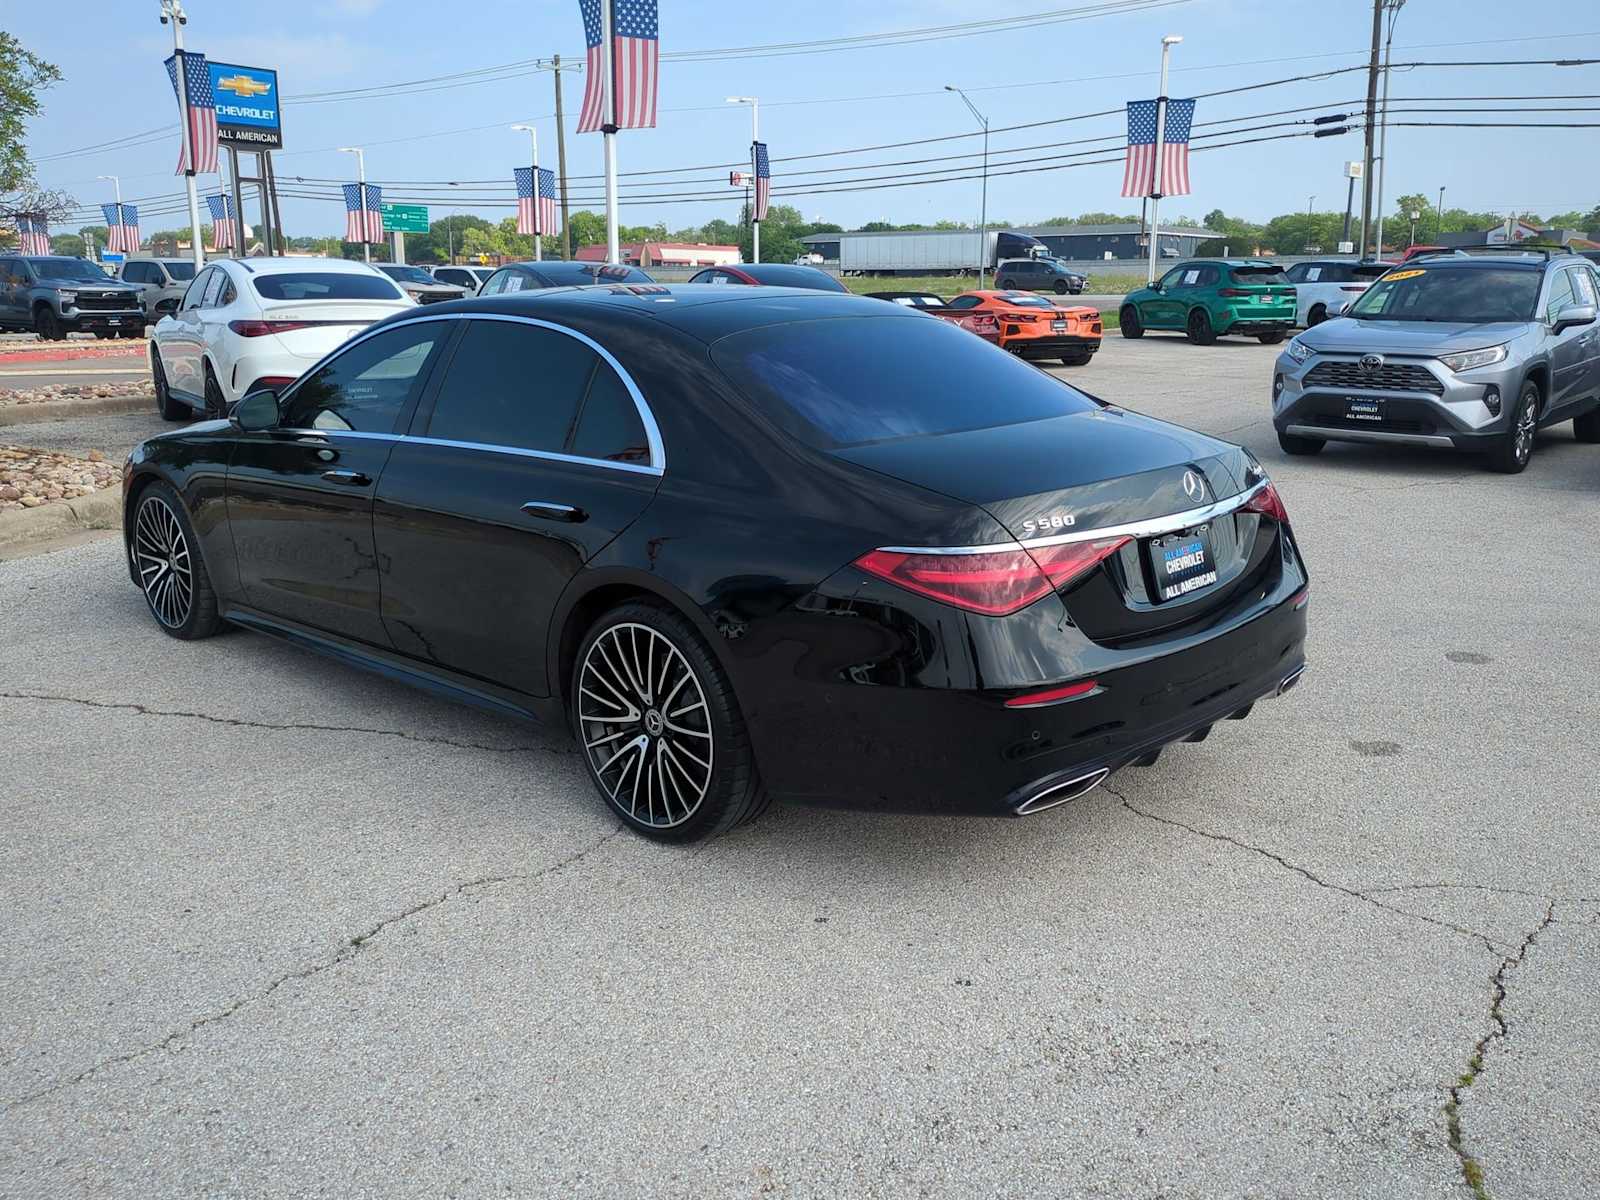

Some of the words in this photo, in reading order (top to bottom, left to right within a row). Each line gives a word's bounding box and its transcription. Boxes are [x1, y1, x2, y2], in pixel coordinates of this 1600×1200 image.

[215, 104, 275, 120] CHEVROLET
[218, 129, 234, 139] ALL
[235, 131, 278, 143] AMERICAN
[1351, 405, 1378, 413] CHEVROLET
[1022, 520, 1036, 532] S
[1037, 515, 1076, 529] 580
[1166, 550, 1205, 574] CHEVROLET
[1166, 584, 1181, 598] ALL
[1180, 571, 1217, 593] AMERICAN
